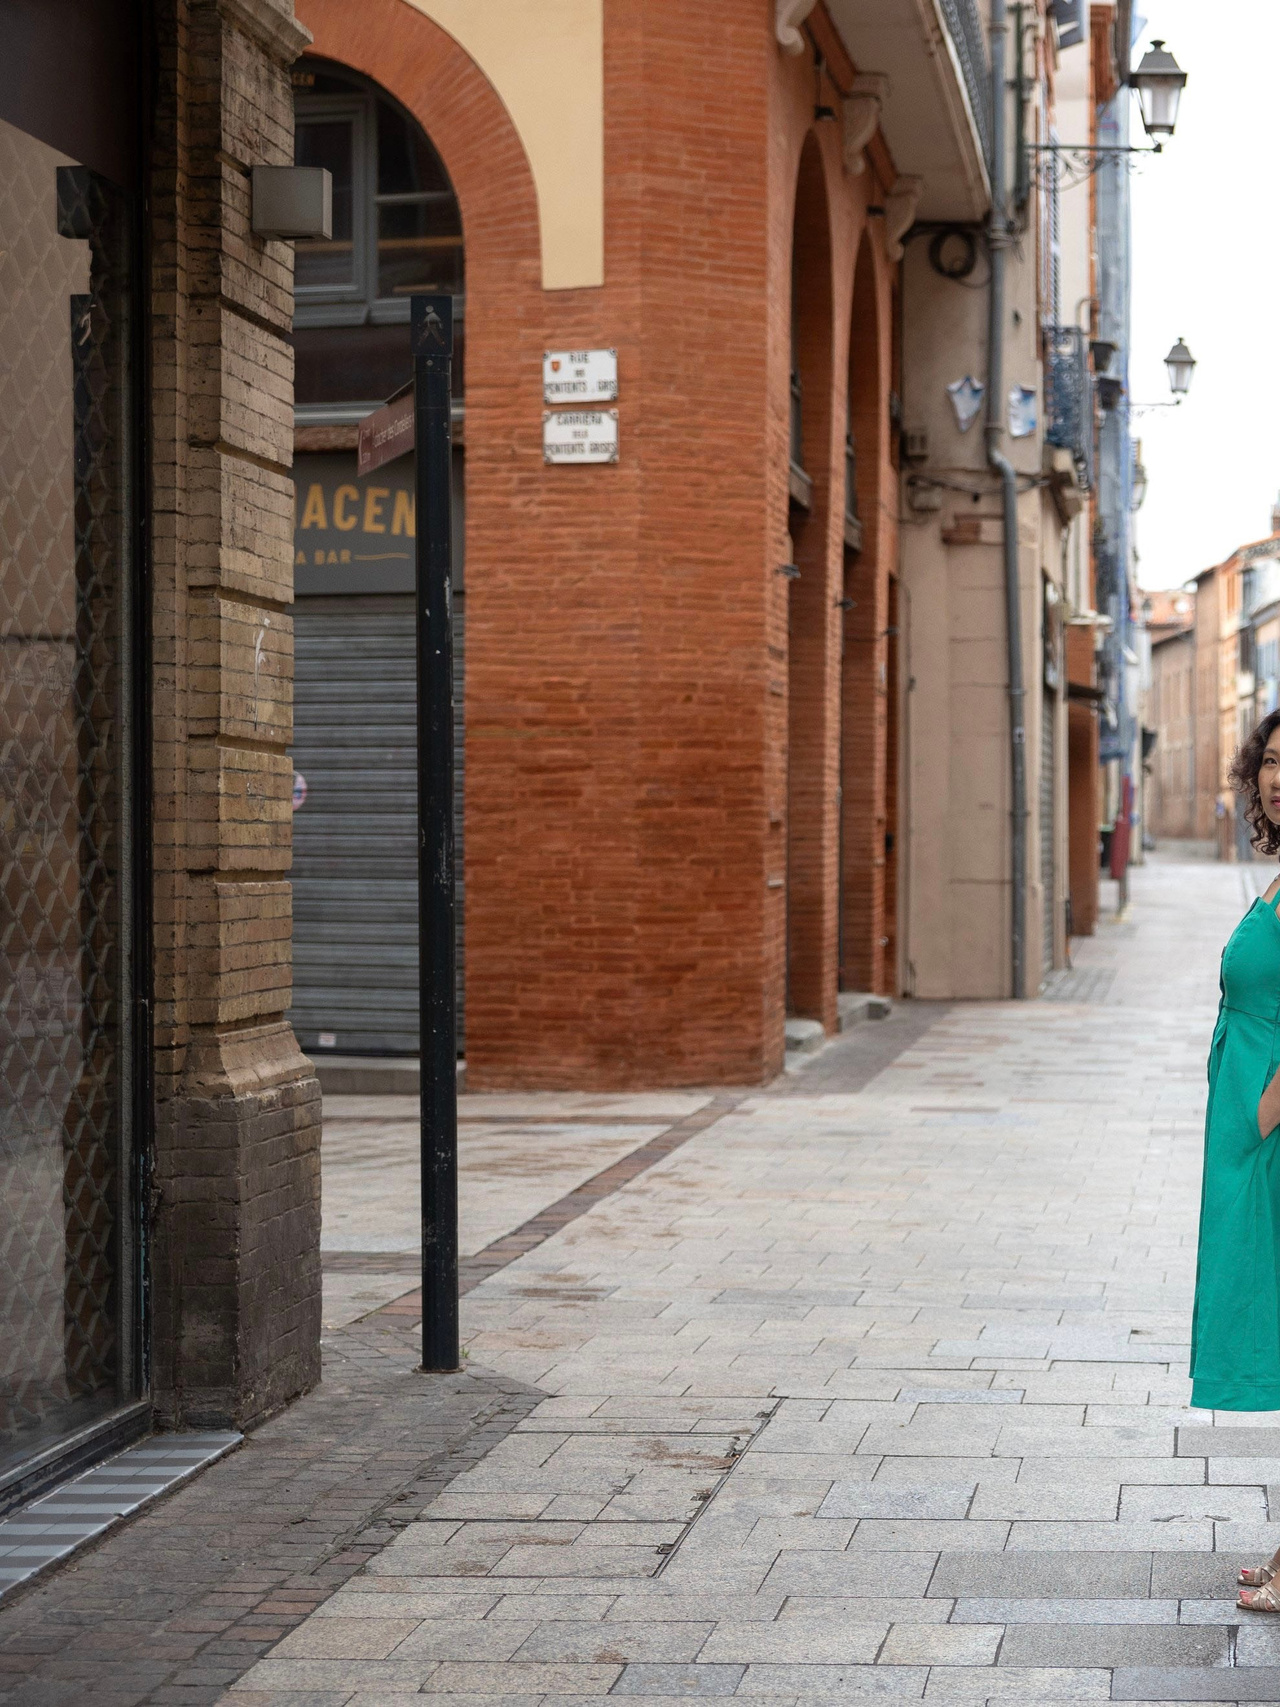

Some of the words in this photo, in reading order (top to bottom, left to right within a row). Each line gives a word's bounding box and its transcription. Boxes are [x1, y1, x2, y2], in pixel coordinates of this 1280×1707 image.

[569, 351, 589, 363] RUE
[598, 380, 617, 391] GRIS
[294, 483, 416, 538] ACEN
[314, 549, 352, 565] BAR
